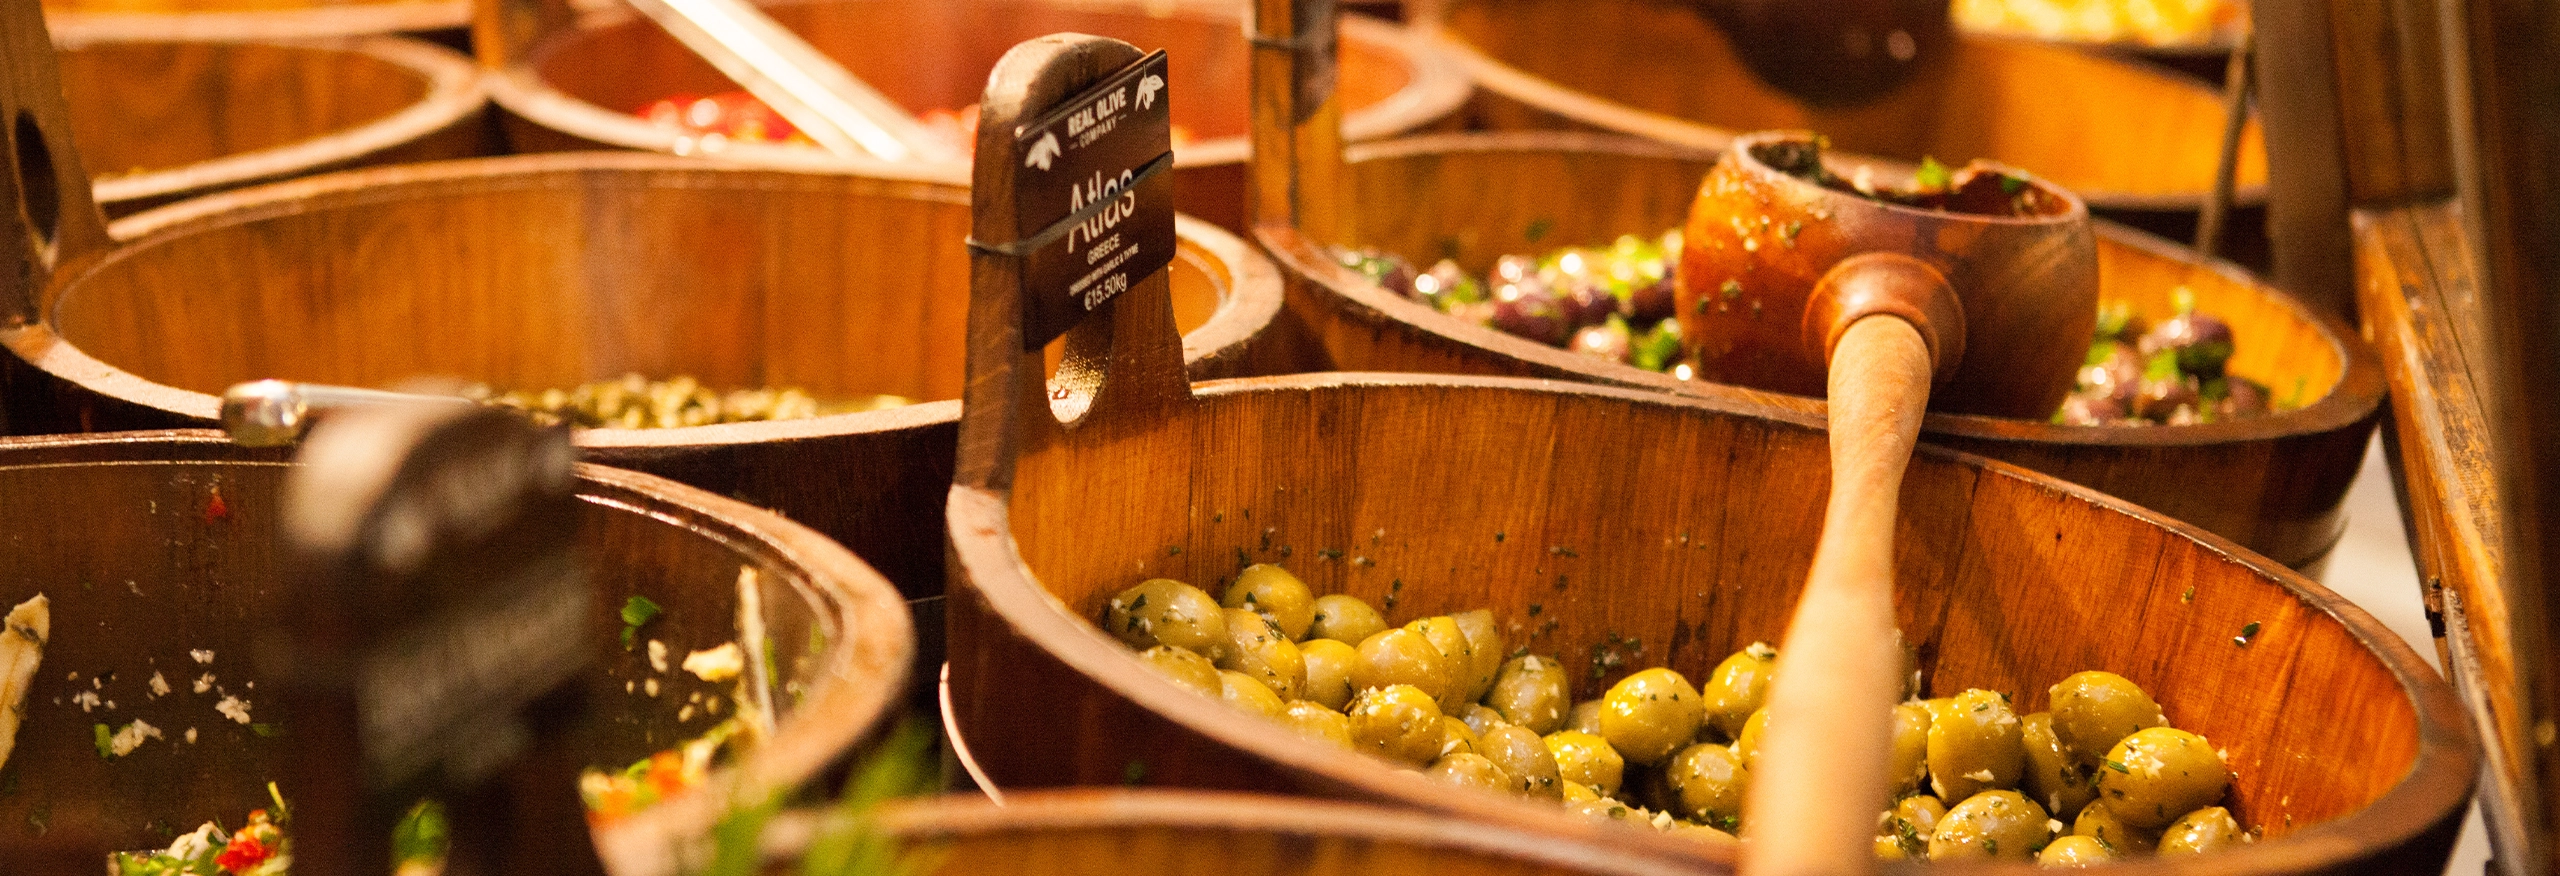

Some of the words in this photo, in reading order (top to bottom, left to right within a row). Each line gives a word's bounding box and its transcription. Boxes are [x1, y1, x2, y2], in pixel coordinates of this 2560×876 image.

[1068, 106, 1095, 137] REAL
[1097, 87, 1126, 120] OLIVE
[1080, 115, 1116, 148] COMPANY
[1068, 169, 1134, 254] Atlas
[1087, 233, 1120, 265] GREECE
[1084, 273, 1127, 311] €15.50kg
